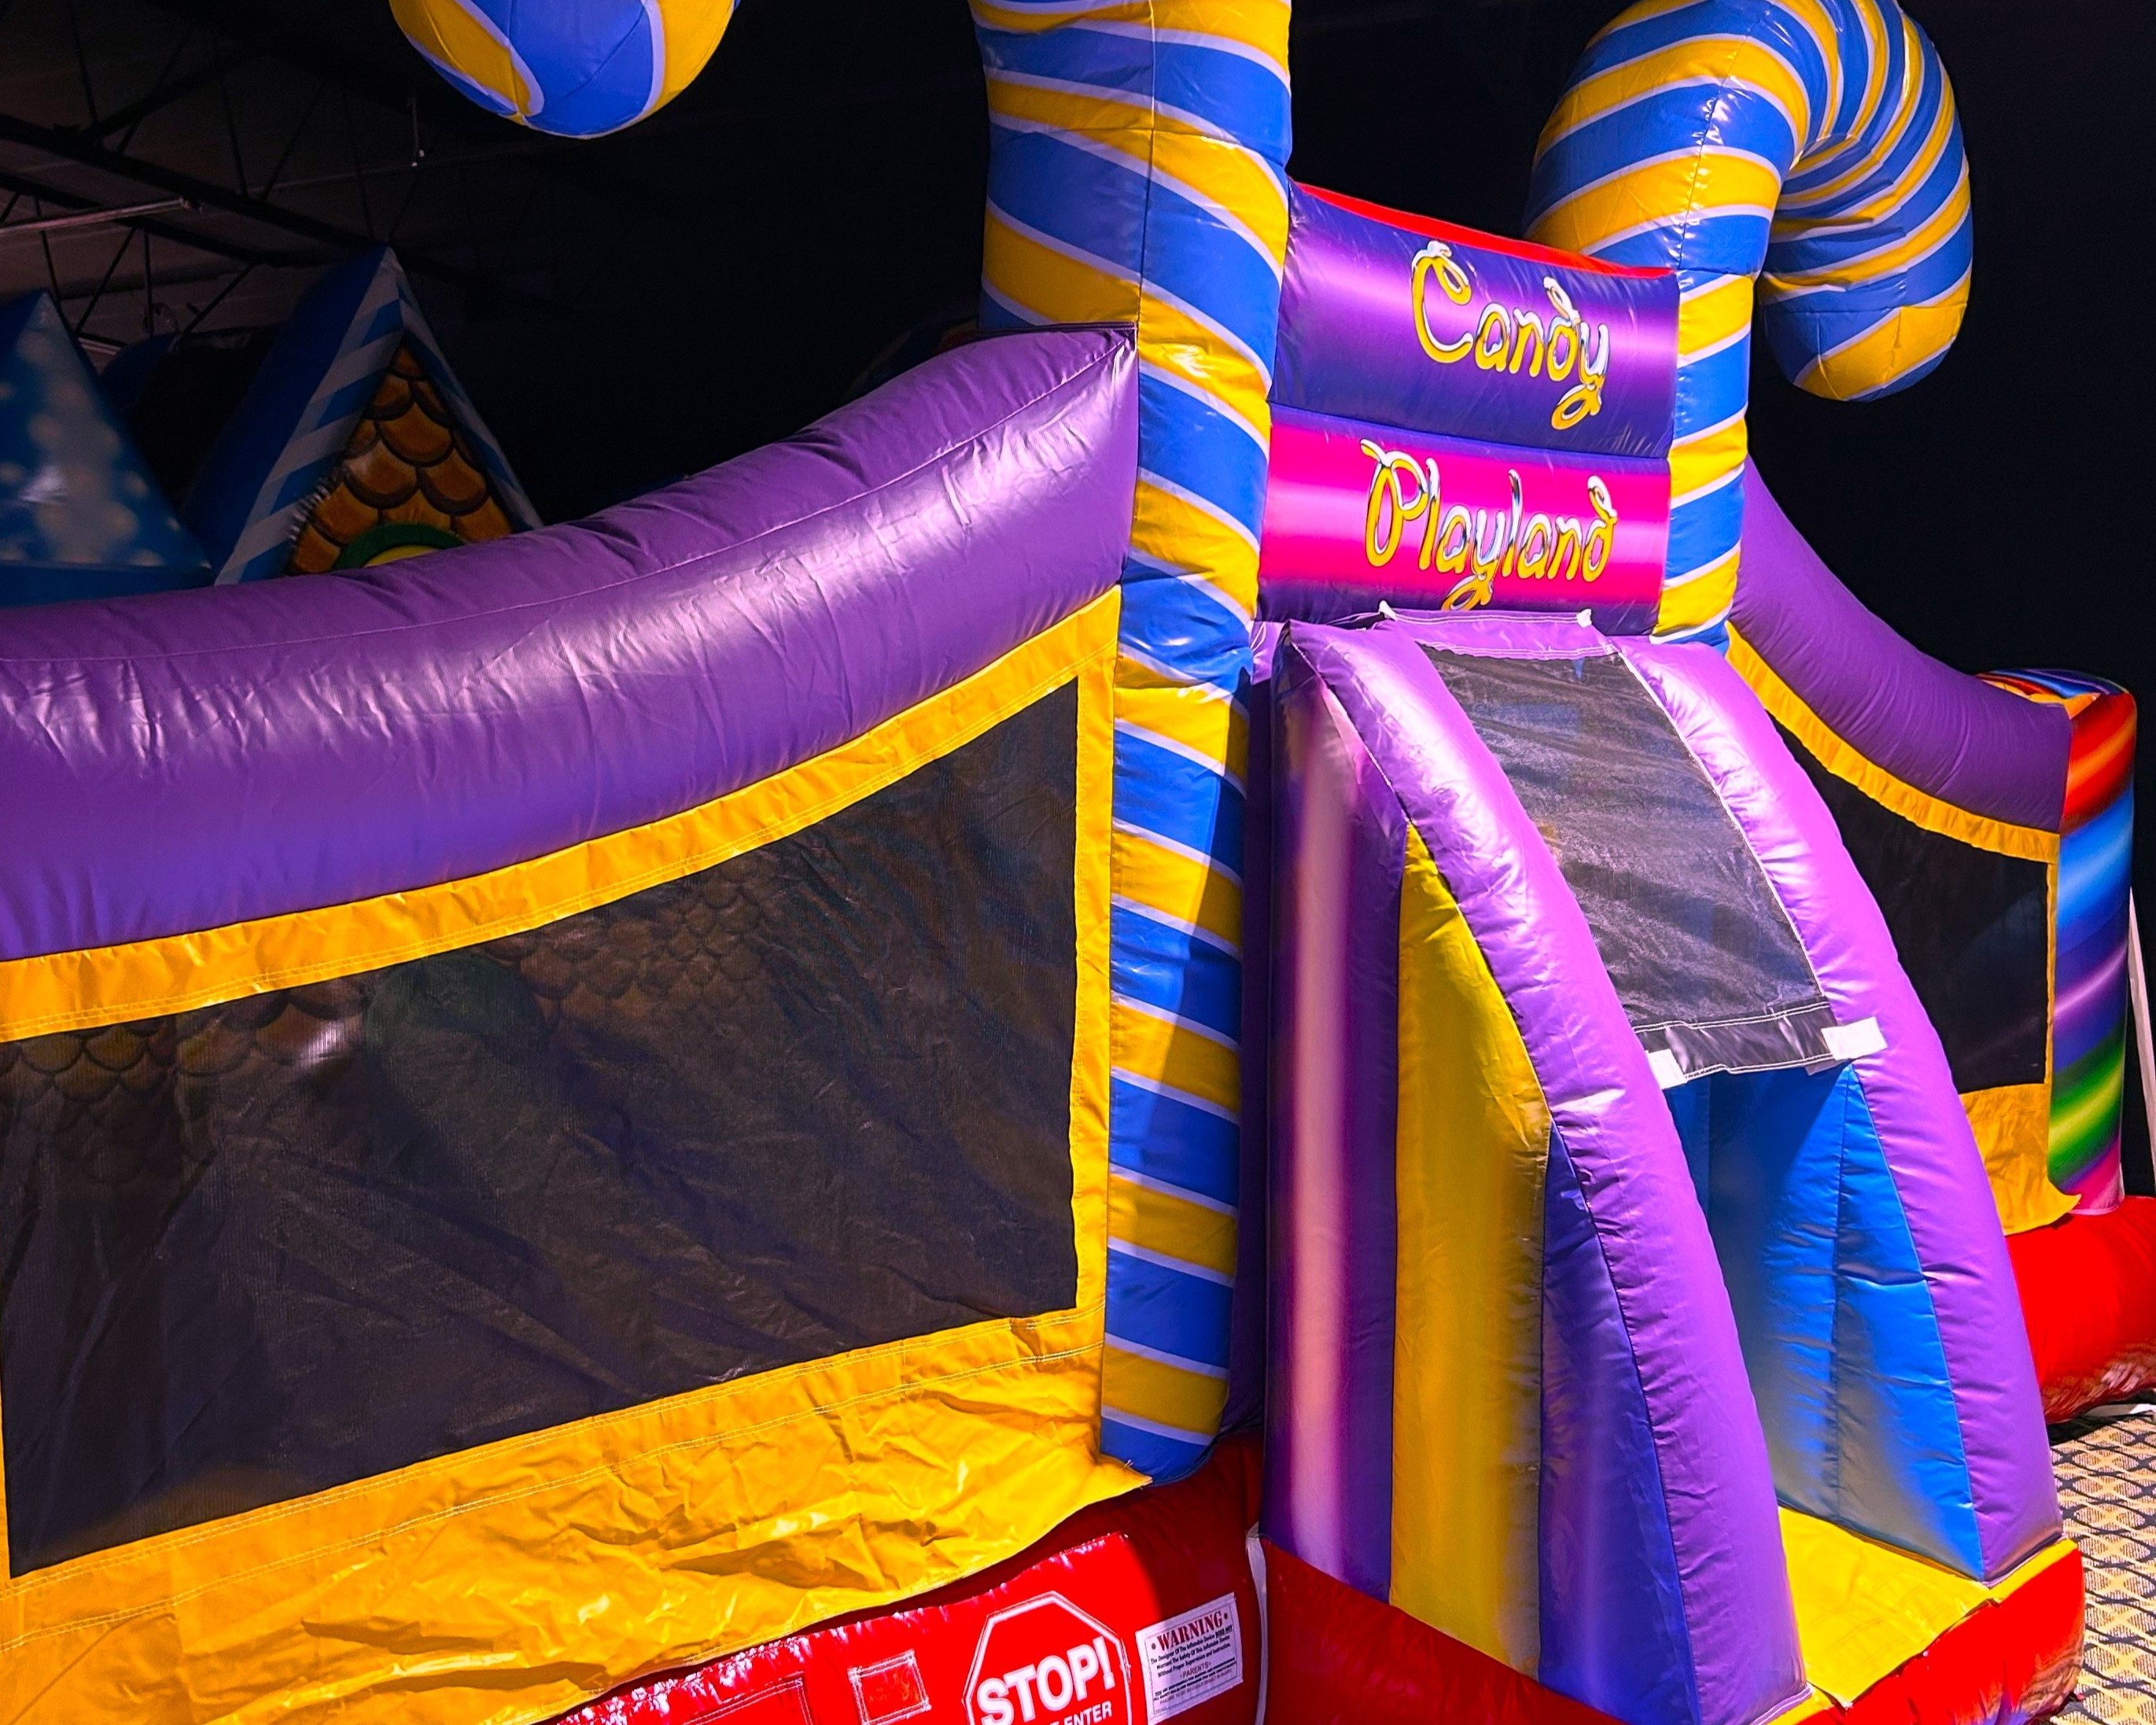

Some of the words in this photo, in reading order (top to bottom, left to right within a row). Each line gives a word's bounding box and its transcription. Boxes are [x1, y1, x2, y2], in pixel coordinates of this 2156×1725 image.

[1411, 240, 1609, 430] Candy
[1360, 438, 1617, 611] Playland
[1157, 1610, 1222, 1651] WARNING
[977, 1636, 1115, 1725] STOP!
[1063, 1701, 1112, 1725] ENTER
